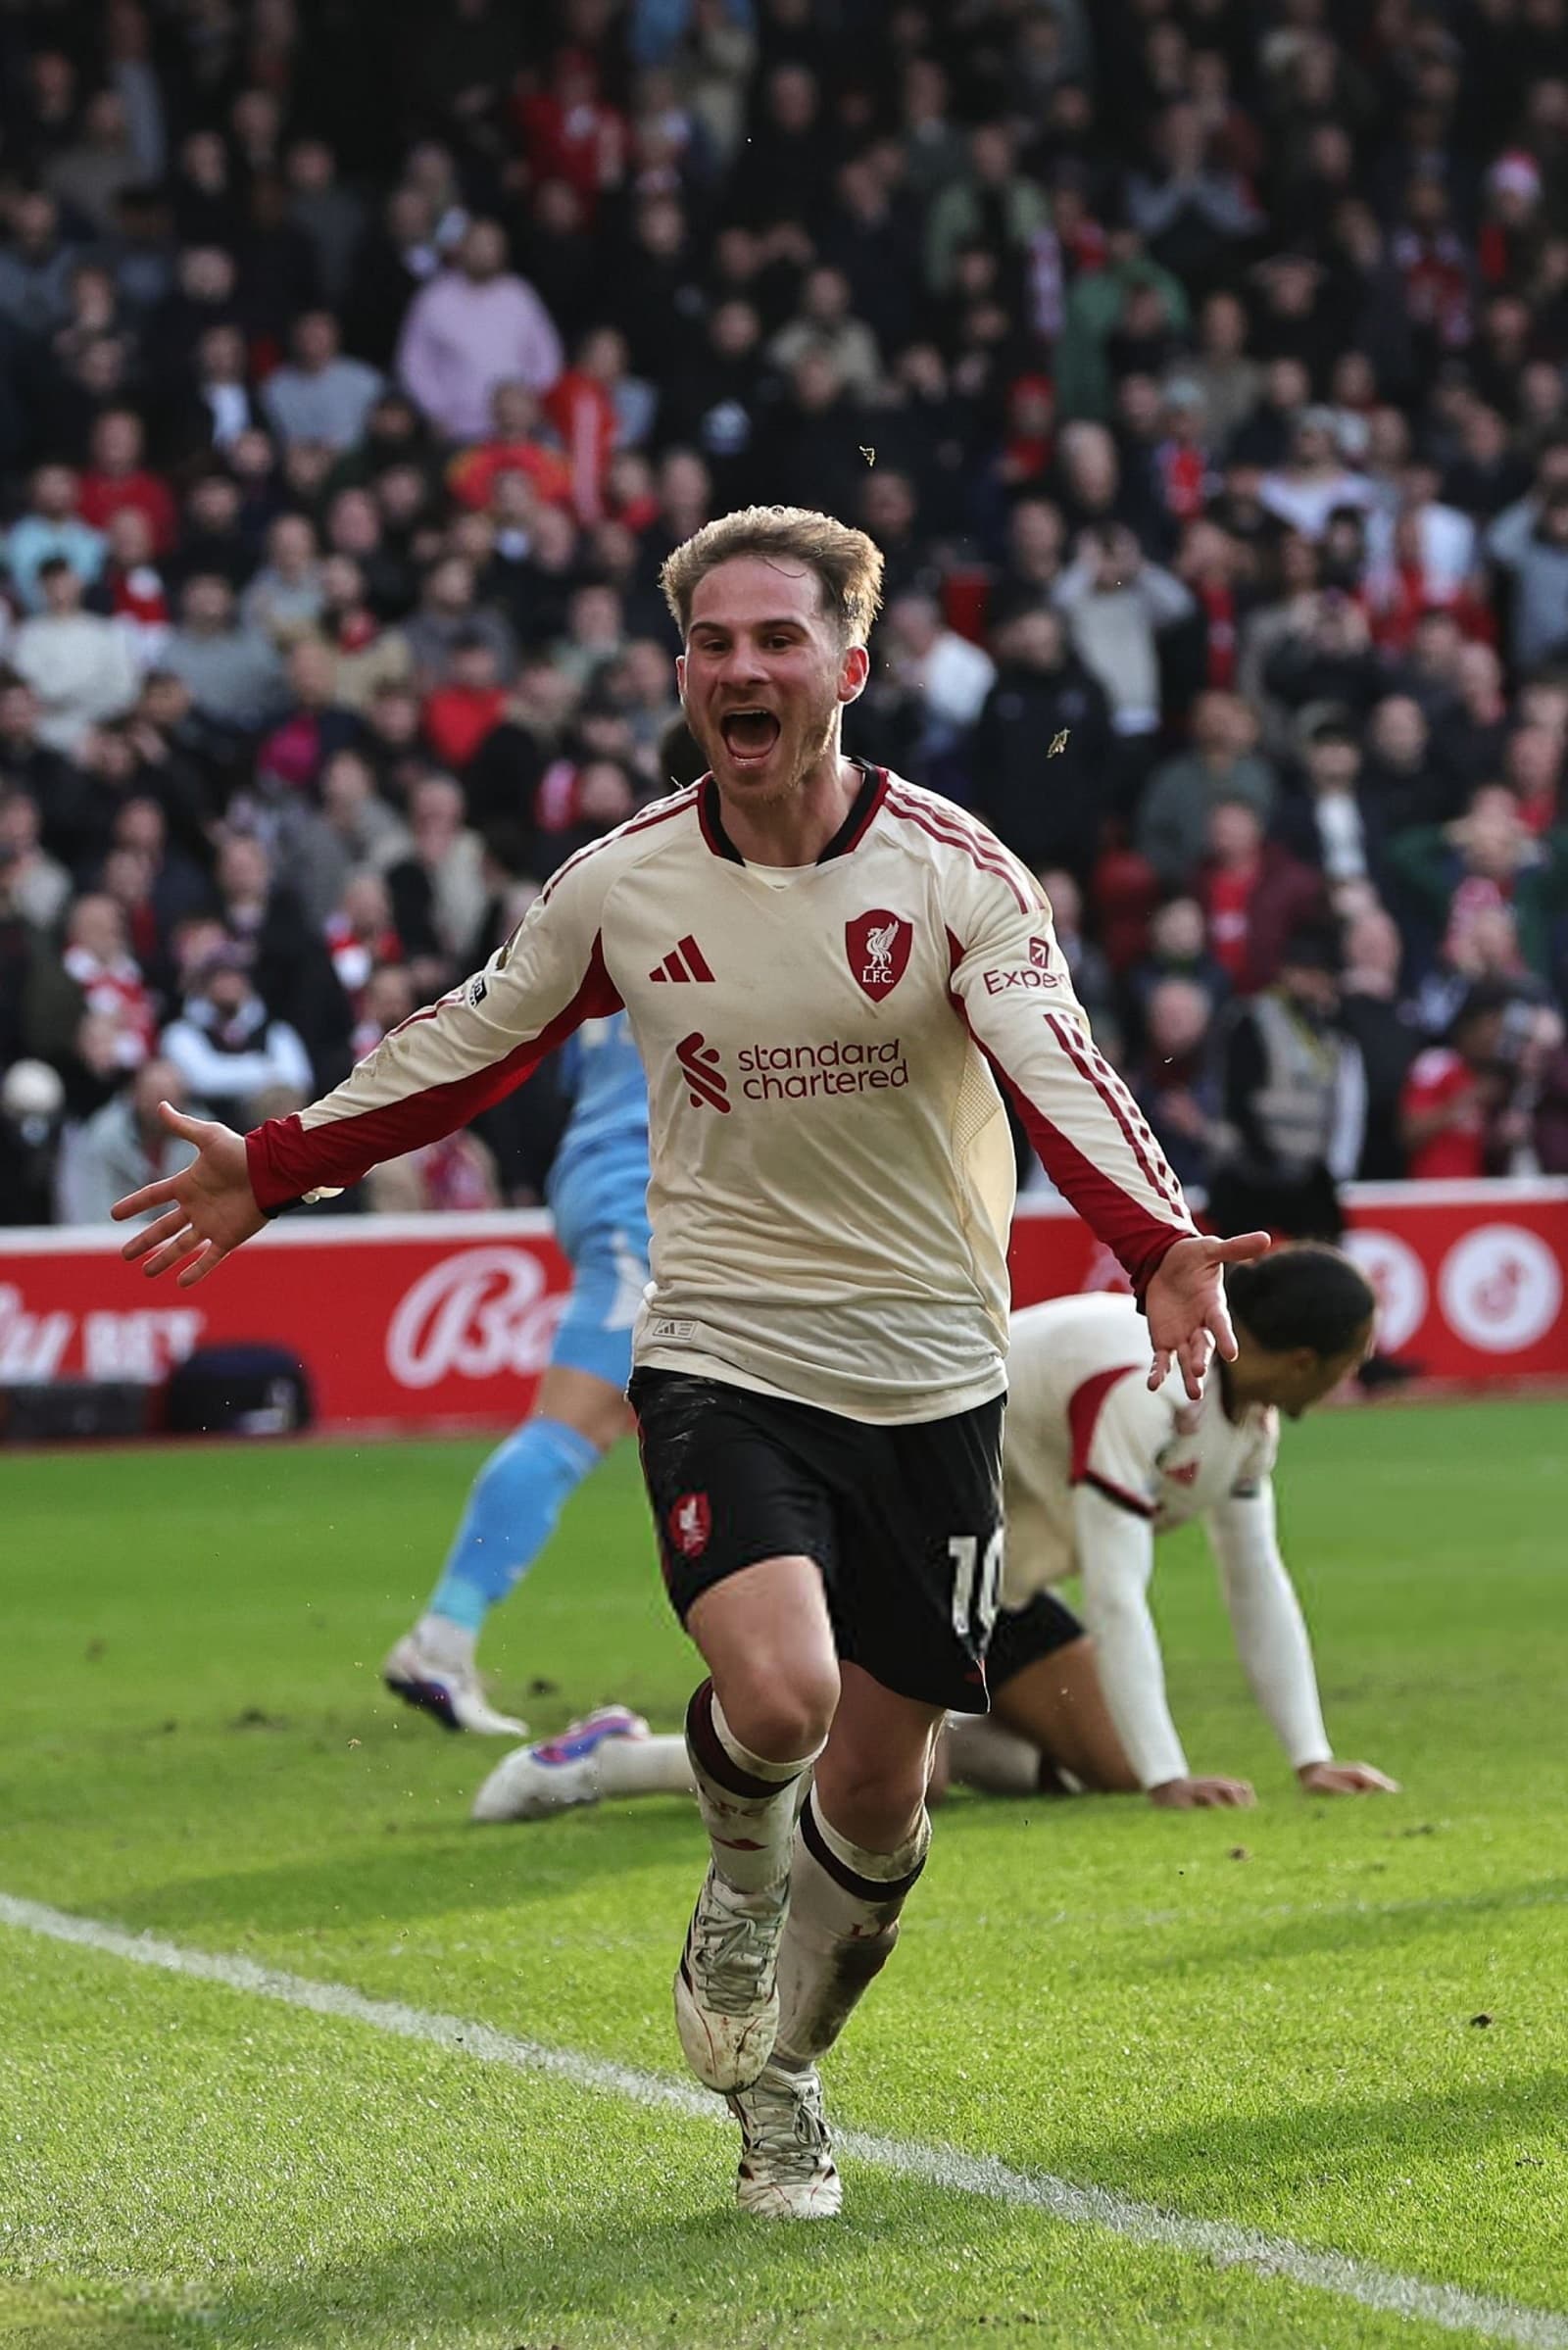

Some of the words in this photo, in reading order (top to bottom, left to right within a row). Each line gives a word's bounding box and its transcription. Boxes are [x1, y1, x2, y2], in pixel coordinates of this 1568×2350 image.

[982, 969, 1071, 996] Expe
[738, 1038, 900, 1071] standard
[743, 1058, 909, 1100] chartered
